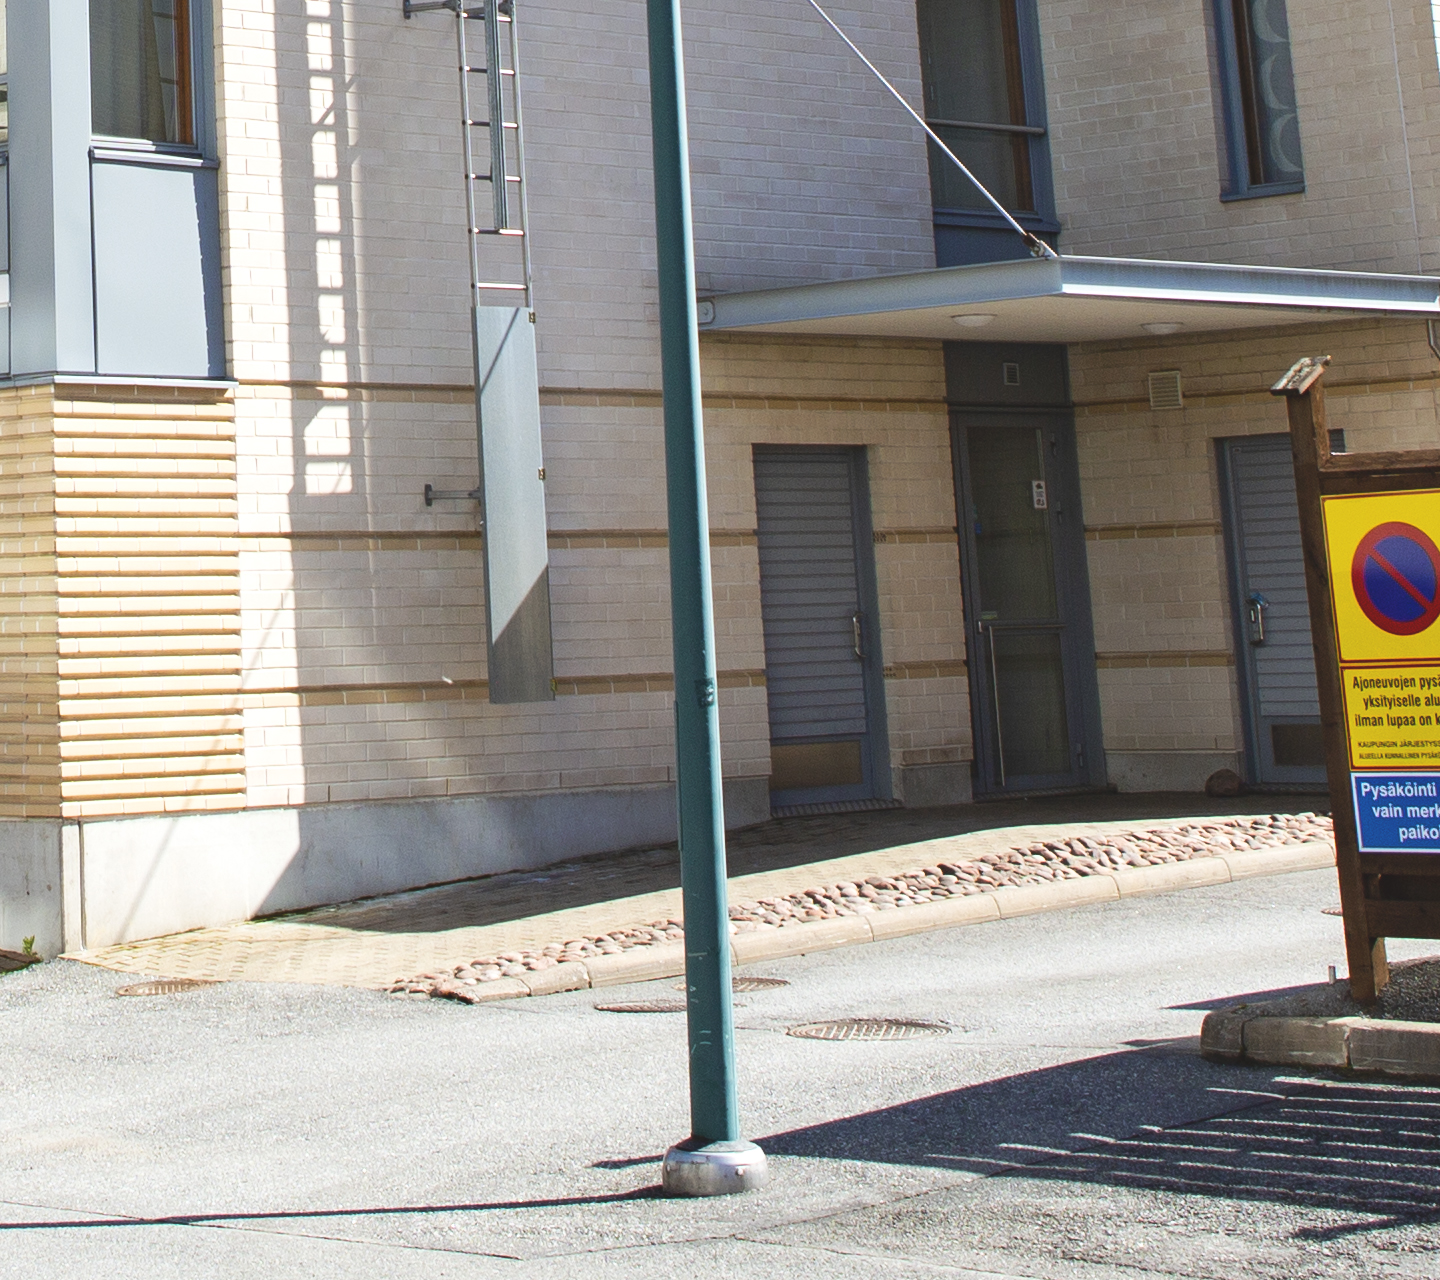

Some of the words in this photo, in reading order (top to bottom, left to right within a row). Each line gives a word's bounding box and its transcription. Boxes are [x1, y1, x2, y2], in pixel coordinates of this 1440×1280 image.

[1352, 675, 1416, 691] Ajoneuvojen
[1363, 694, 1421, 710] yksityiselle
[1354, 714, 1384, 727] ilman
[1387, 714, 1416, 729] lupaa
[1419, 716, 1432, 726] on
[1360, 782, 1437, 800] Pysäköinti
[1372, 803, 1403, 818] vain
